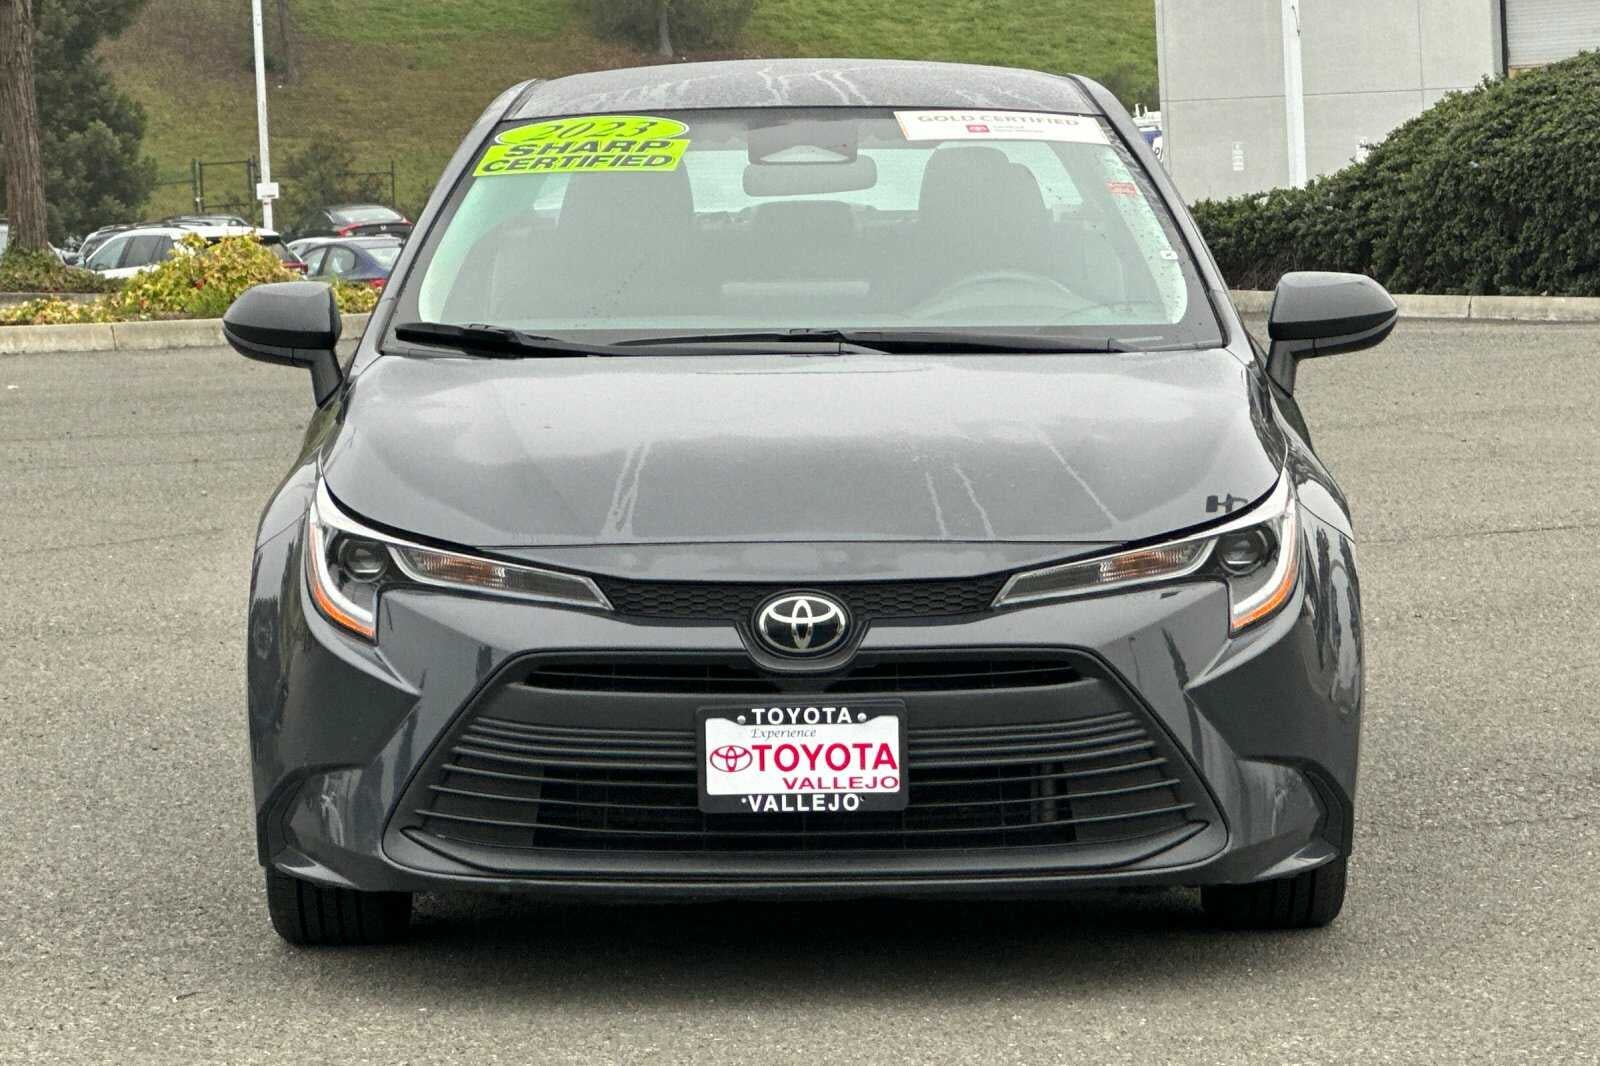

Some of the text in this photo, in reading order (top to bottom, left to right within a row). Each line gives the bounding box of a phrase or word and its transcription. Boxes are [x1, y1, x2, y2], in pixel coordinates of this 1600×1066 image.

[980, 115, 1079, 126] CERTIFIED
[522, 121, 657, 141] 2023
[504, 140, 671, 157] SHARP
[482, 155, 673, 172] CERTIFIED
[752, 707, 852, 724] TOYOTA
[751, 728, 817, 741] Experience
[751, 743, 898, 772] TOYOTA
[782, 776, 899, 790] VALLEJO
[748, 793, 860, 812] VALLEJO
